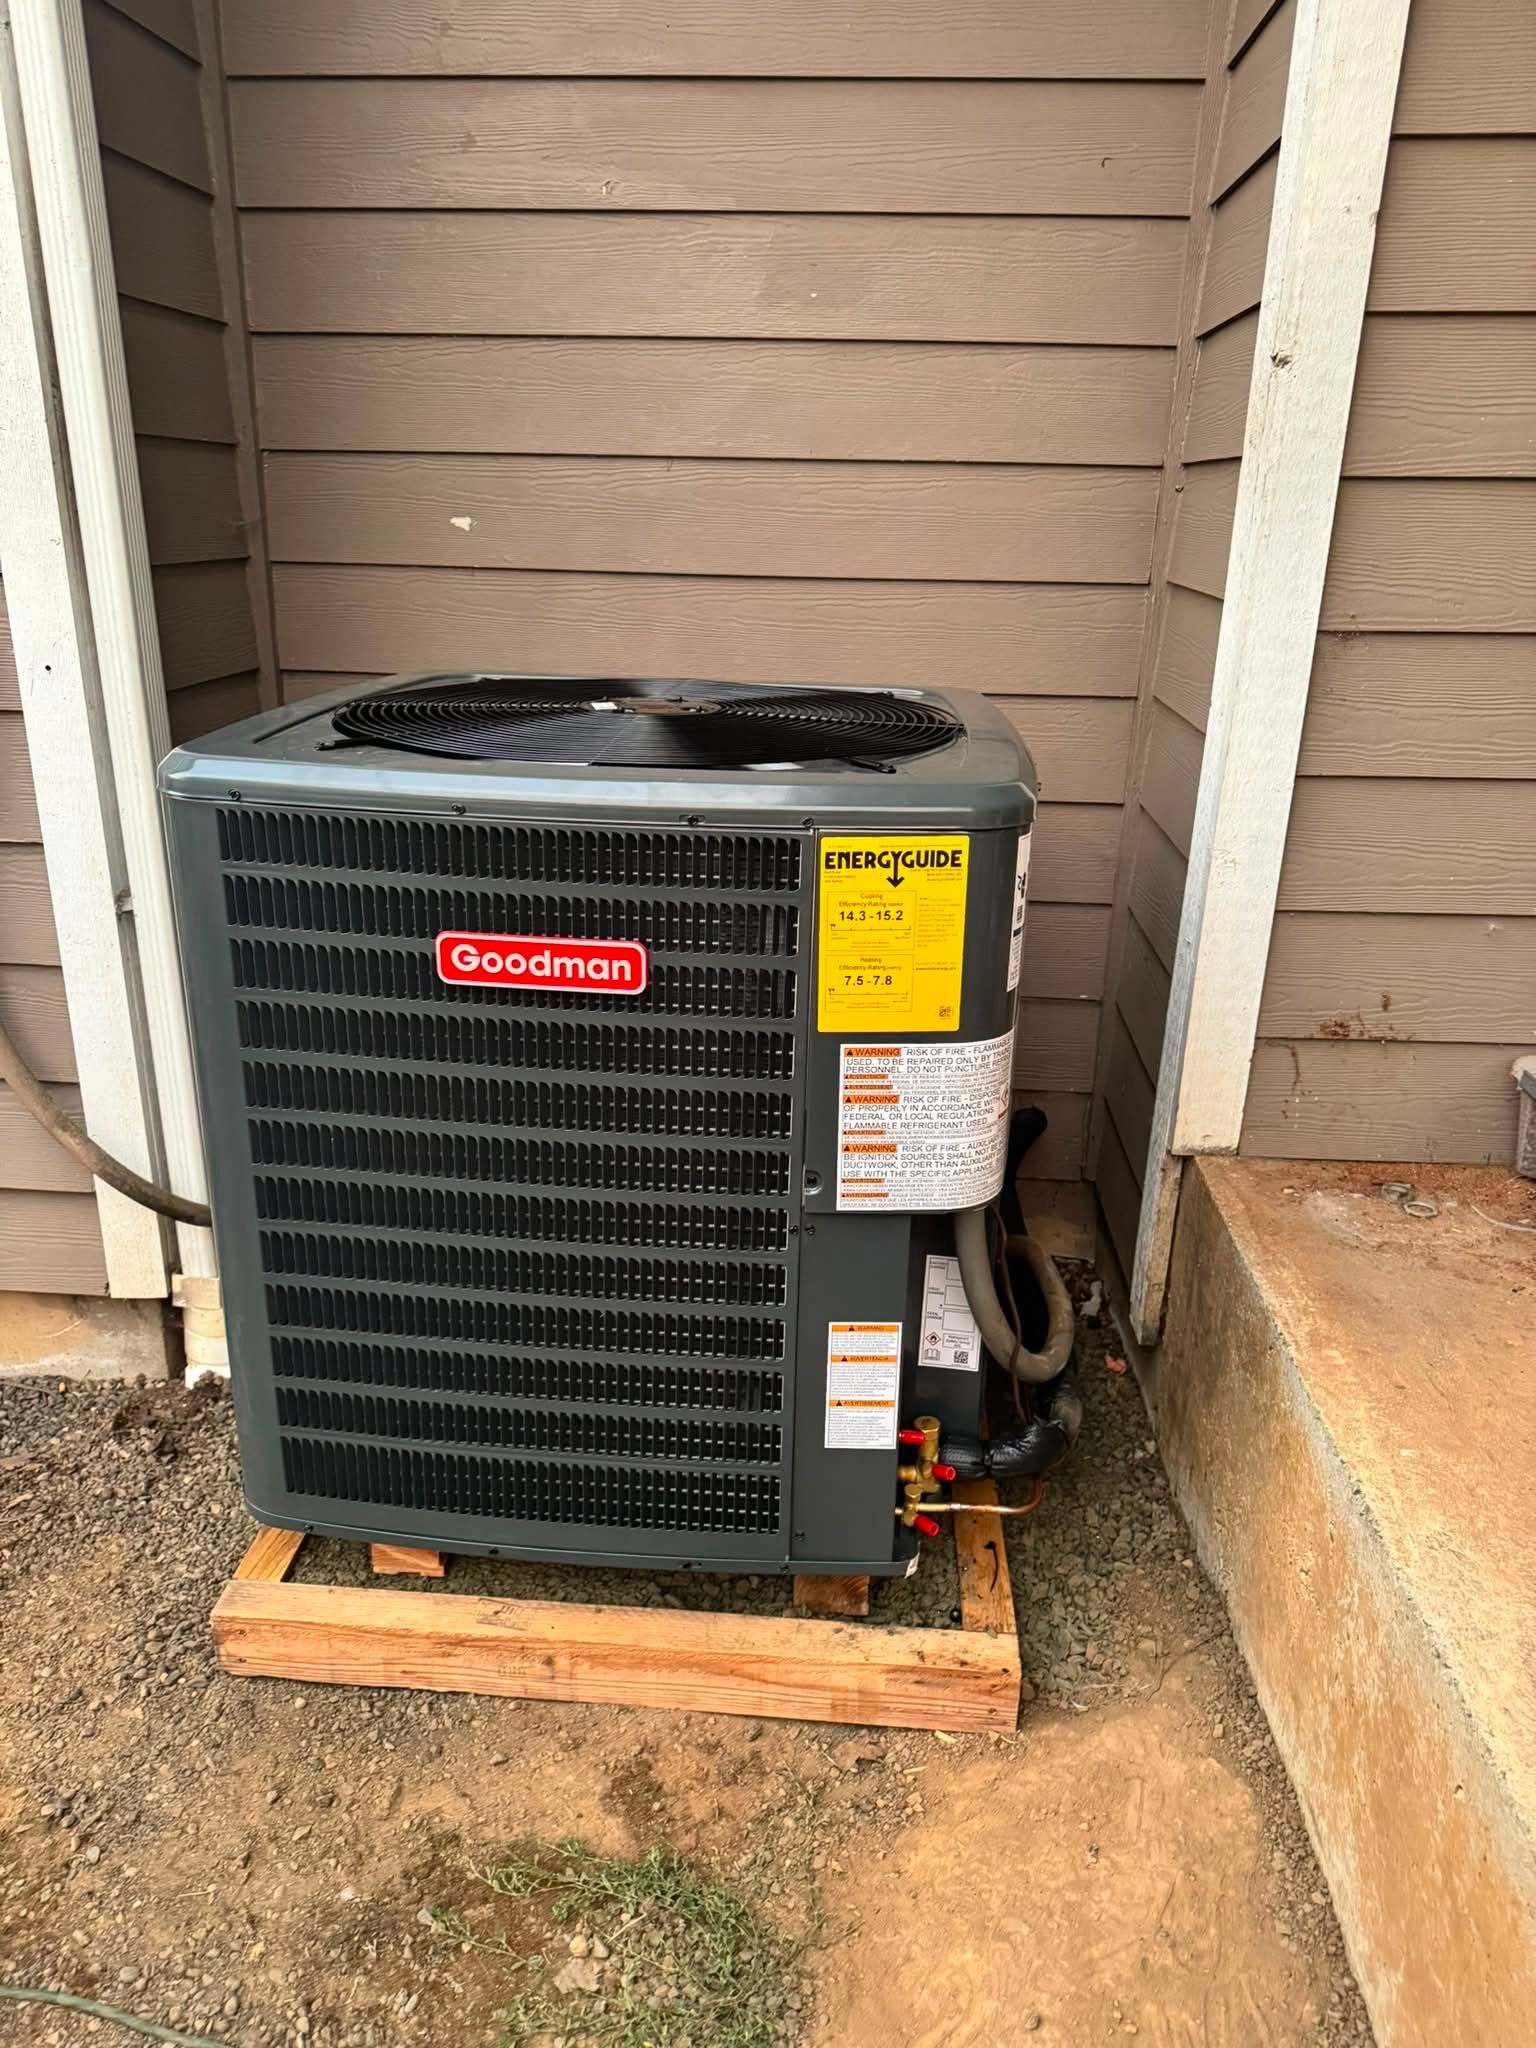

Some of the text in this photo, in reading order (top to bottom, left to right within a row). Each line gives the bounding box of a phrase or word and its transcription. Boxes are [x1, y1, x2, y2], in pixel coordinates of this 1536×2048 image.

[825, 850, 963, 870] ENERGYGUIDE
[839, 910, 866, 921] 14.3
[876, 910, 904, 921] 15.2
[451, 943, 632, 982] Goodman
[844, 975, 864, 986] 7.5
[873, 975, 893, 986] 7.8
[855, 1048, 900, 1056] WARNING
[906, 1048, 928, 1056] RISK
[930, 1048, 943, 1056] OF
[945, 1048, 966, 1056] FIRE
[877, 1058, 890, 1066] TO
[892, 1058, 904, 1066] BE
[907, 1057, 954, 1066] REPAIRED
[955, 1055, 979, 1065] ONLY
[981, 1054, 991, 1062] BY
[922, 1065, 942, 1073] NOT
[944, 1061, 991, 1073] PUNCTURE
[853, 1095, 898, 1103] WARNING
[903, 1096, 925, 1104] RISK
[942, 1095, 962, 1103] FIRE
[858, 1105, 908, 1113] PROPERLY
[921, 1101, 982, 1112] ACCORDANCE
[843, 1122, 897, 1130] FLAMMABLE
[900, 1121, 964, 1130] REFRIGERANT
[858, 1153, 898, 1161] IGNITION
[900, 1153, 945, 1161] SOURCES
[946, 1152, 973, 1160] SHALL
[975, 1146, 989, 1157] NOT
[940, 1144, 960, 1152] FIRE
[901, 1161, 933, 1169] OTHER
[843, 1170, 861, 1178] USE
[910, 1170, 951, 1178] SPECIFIC
